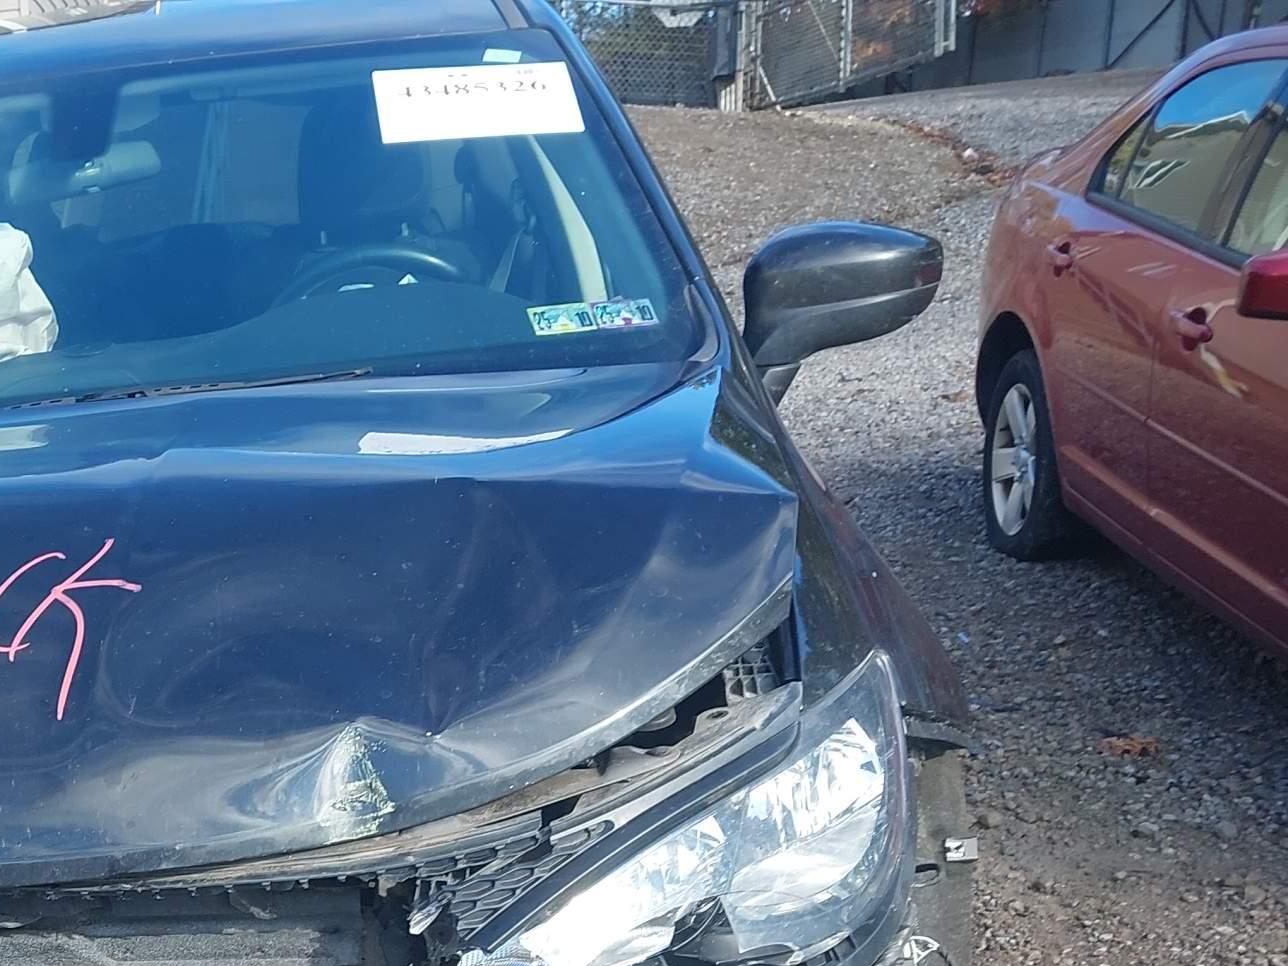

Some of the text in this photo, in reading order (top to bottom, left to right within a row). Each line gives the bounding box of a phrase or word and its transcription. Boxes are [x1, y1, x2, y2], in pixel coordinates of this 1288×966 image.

[532, 311, 594, 331] 25 10
[596, 304, 654, 325] 25 10
